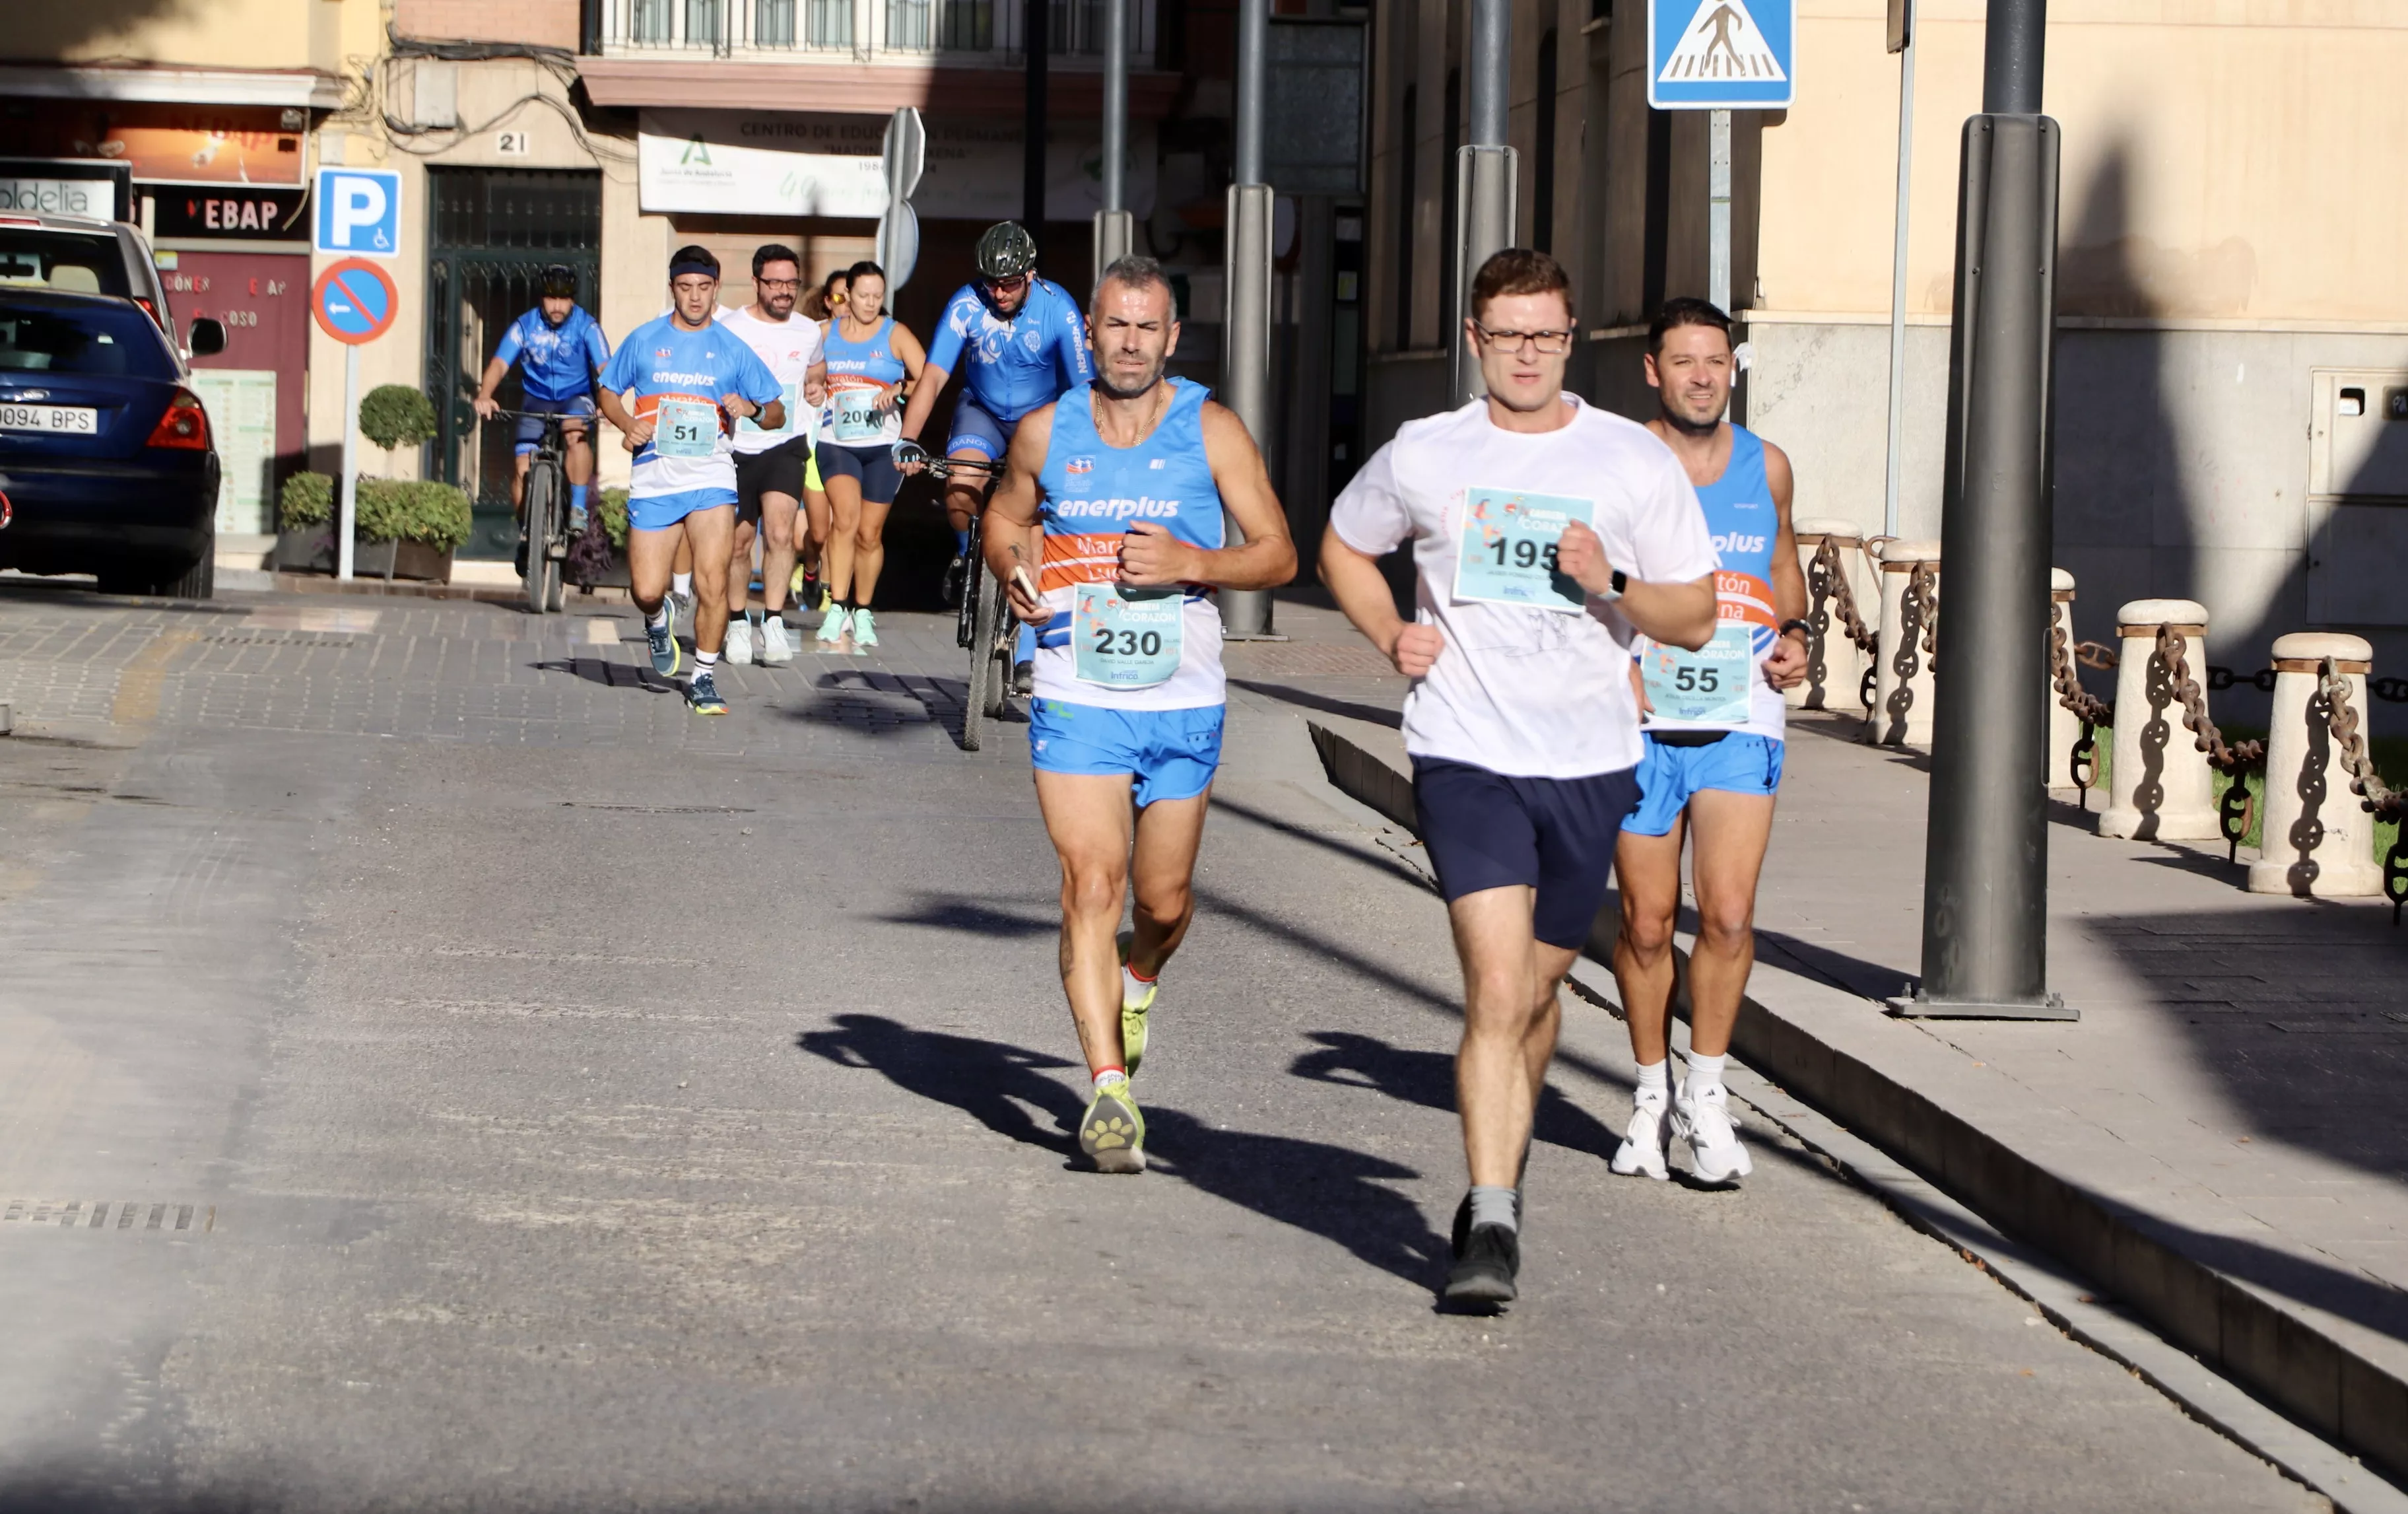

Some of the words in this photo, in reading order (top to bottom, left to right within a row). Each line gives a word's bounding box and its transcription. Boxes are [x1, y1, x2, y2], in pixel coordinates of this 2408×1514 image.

[740, 123, 807, 137] CENTRO
[813, 125, 832, 139] DE
[840, 125, 936, 141] EDUCN
[500, 135, 525, 152] 21
[858, 162, 884, 171] 198
[333, 176, 386, 246] P
[653, 372, 717, 386] enerplus
[0, 407, 41, 427] 094
[52, 410, 89, 430] BPS
[674, 425, 697, 442] 51
[1057, 497, 1179, 520] enerplus
[1522, 518, 1569, 533] CORAZ
[1077, 537, 1124, 555] Mara
[1711, 532, 1766, 553] plus
[1490, 537, 1558, 571] 195
[1096, 628, 1162, 656] 230
[1675, 666, 1718, 692] 55
